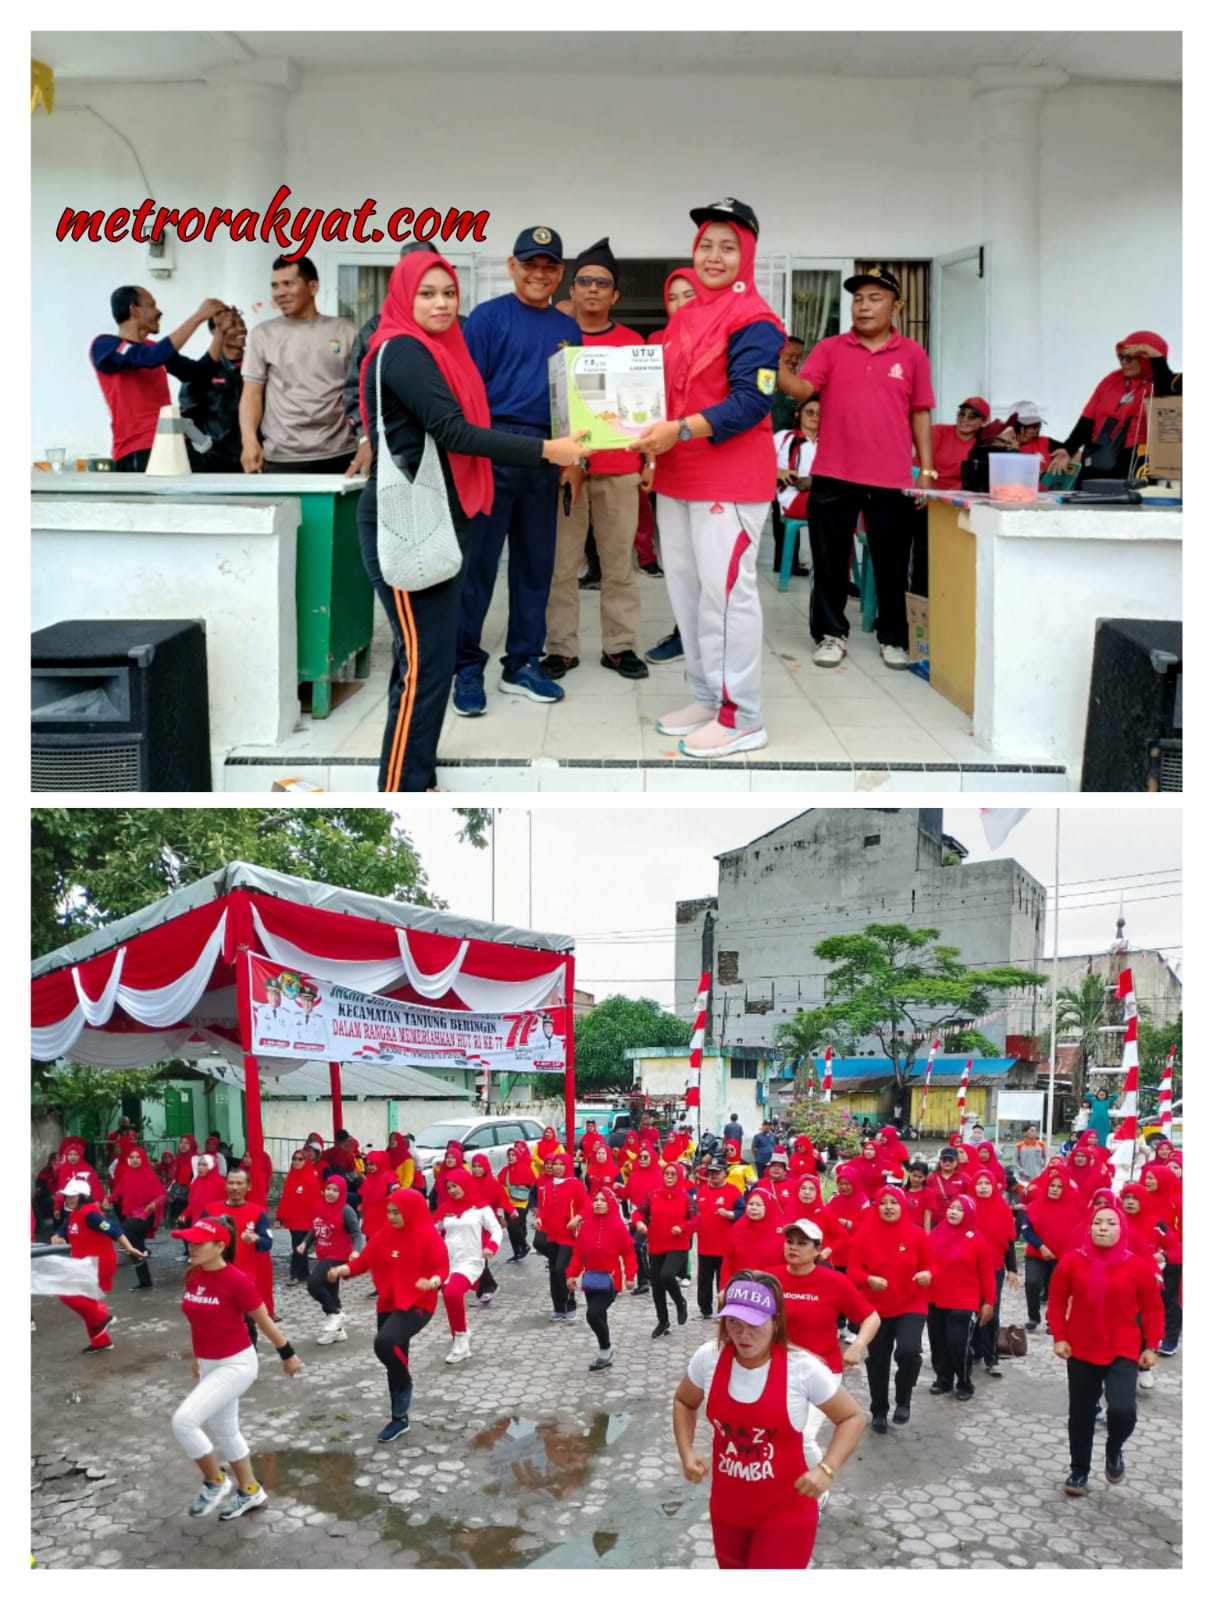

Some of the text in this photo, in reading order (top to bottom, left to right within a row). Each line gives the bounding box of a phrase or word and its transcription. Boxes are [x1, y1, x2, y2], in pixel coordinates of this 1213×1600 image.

[337, 1002, 400, 1024] KECAMATAN
[403, 1012, 447, 1030] TANJUNG
[450, 1018, 497, 1034] BERINGIN
[332, 1019, 504, 1050] DALAM RANGKA MEMERIAHKAN HUT RI KE 77
[727, 1287, 771, 1308] UMBA
[718, 1452, 775, 1482] ZUMBA
